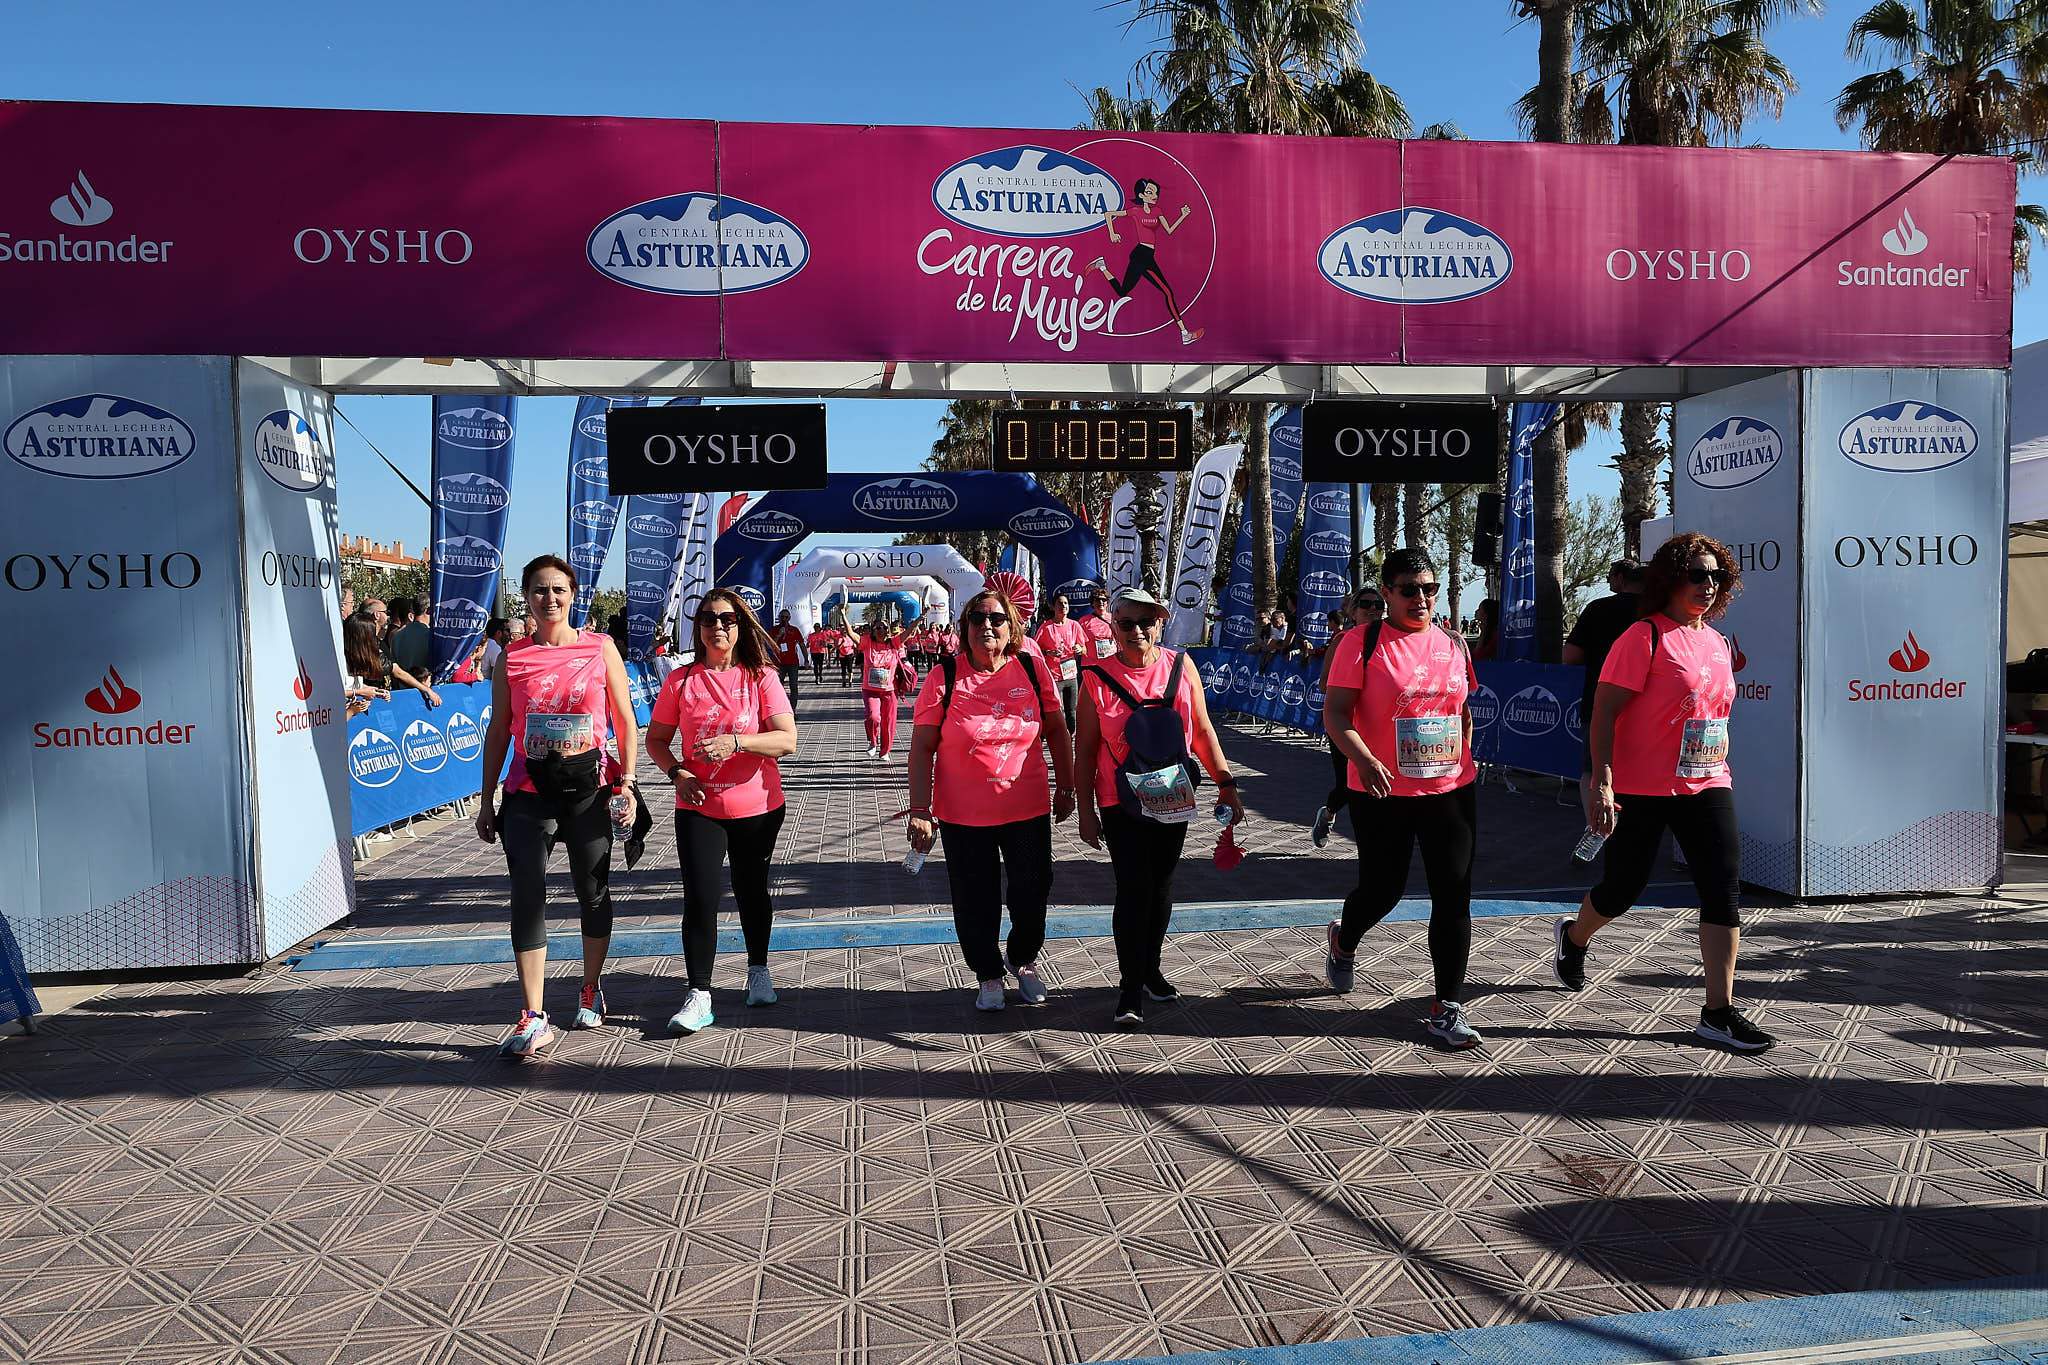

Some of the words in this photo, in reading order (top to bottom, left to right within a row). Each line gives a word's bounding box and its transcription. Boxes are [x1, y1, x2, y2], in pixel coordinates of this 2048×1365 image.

[977, 176, 1037, 186] CENTRAL
[1043, 178, 1103, 188] LECHERA
[0, 233, 173, 263] Santander
[293, 228, 473, 264] OYSHO
[639, 228, 708, 238] CENTRAL
[1363, 241, 1423, 250] CENTRAL
[1430, 241, 1491, 250] LECHERA
[917, 228, 1073, 278] Carrera
[1606, 249, 1750, 281] OYSHO
[1838, 261, 1969, 287] Santander
[956, 280, 985, 311] de
[992, 280, 1012, 312] la
[1009, 275, 1132, 351] Mujer
[48, 424, 108, 433] CENTRAL
[114, 423, 174, 432] LECHERA
[1008, 420, 1176, 460] 01:08:33
[1335, 427, 1470, 457] OYSHO
[643, 433, 796, 466] OYSHO
[1706, 441, 1736, 453] CENTRAL
[1738, 435, 1772, 448] LECHERA
[1175, 471, 1226, 609] OYSHO
[1834, 534, 1978, 568] OYSHO
[4, 552, 201, 591] OYSHO
[262, 551, 331, 590] OYSHO
[843, 551, 924, 569] OYSHO
[1848, 678, 1966, 702] Santander
[34, 720, 196, 748] Santander
[276, 705, 331, 735] Santander
